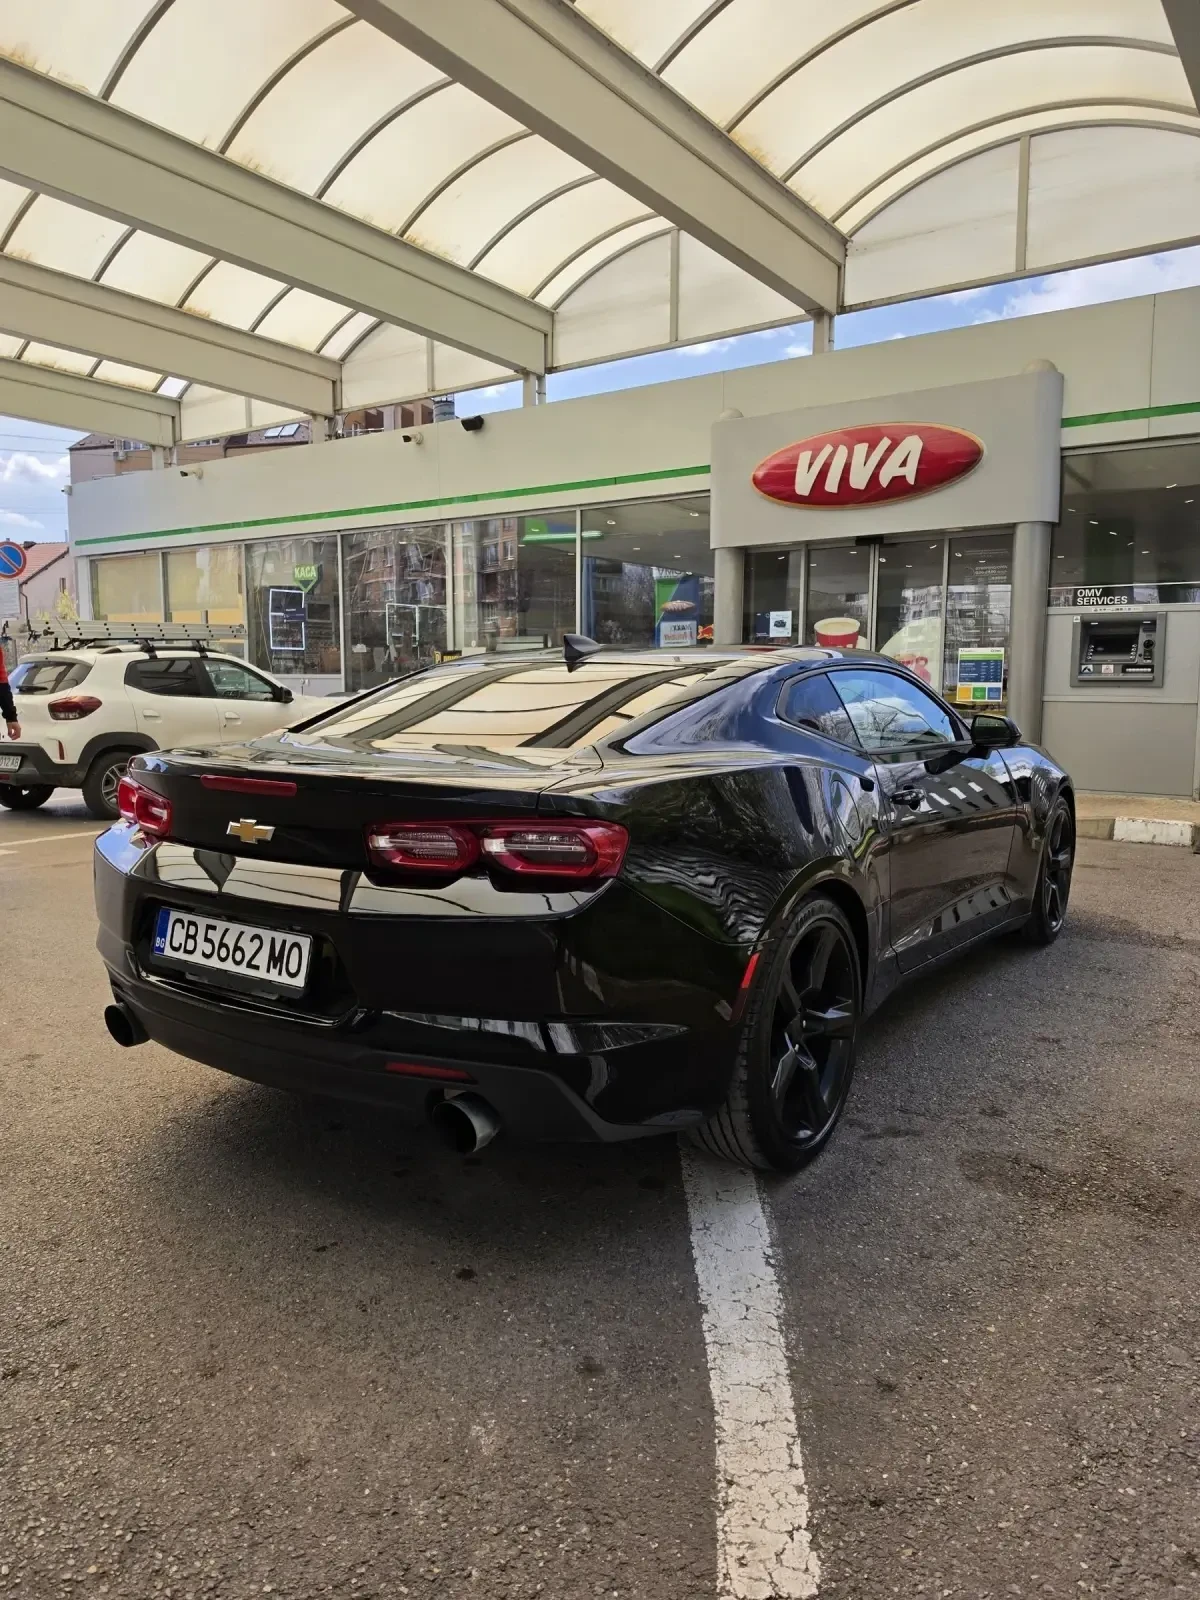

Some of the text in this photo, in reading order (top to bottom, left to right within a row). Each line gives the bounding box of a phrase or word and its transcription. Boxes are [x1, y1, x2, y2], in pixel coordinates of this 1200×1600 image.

[794, 434, 924, 497] VIVA
[294, 566, 317, 578] КАСА
[1077, 588, 1102, 597] OMV
[1076, 595, 1128, 605] SERVICES
[155, 937, 166, 949] BG
